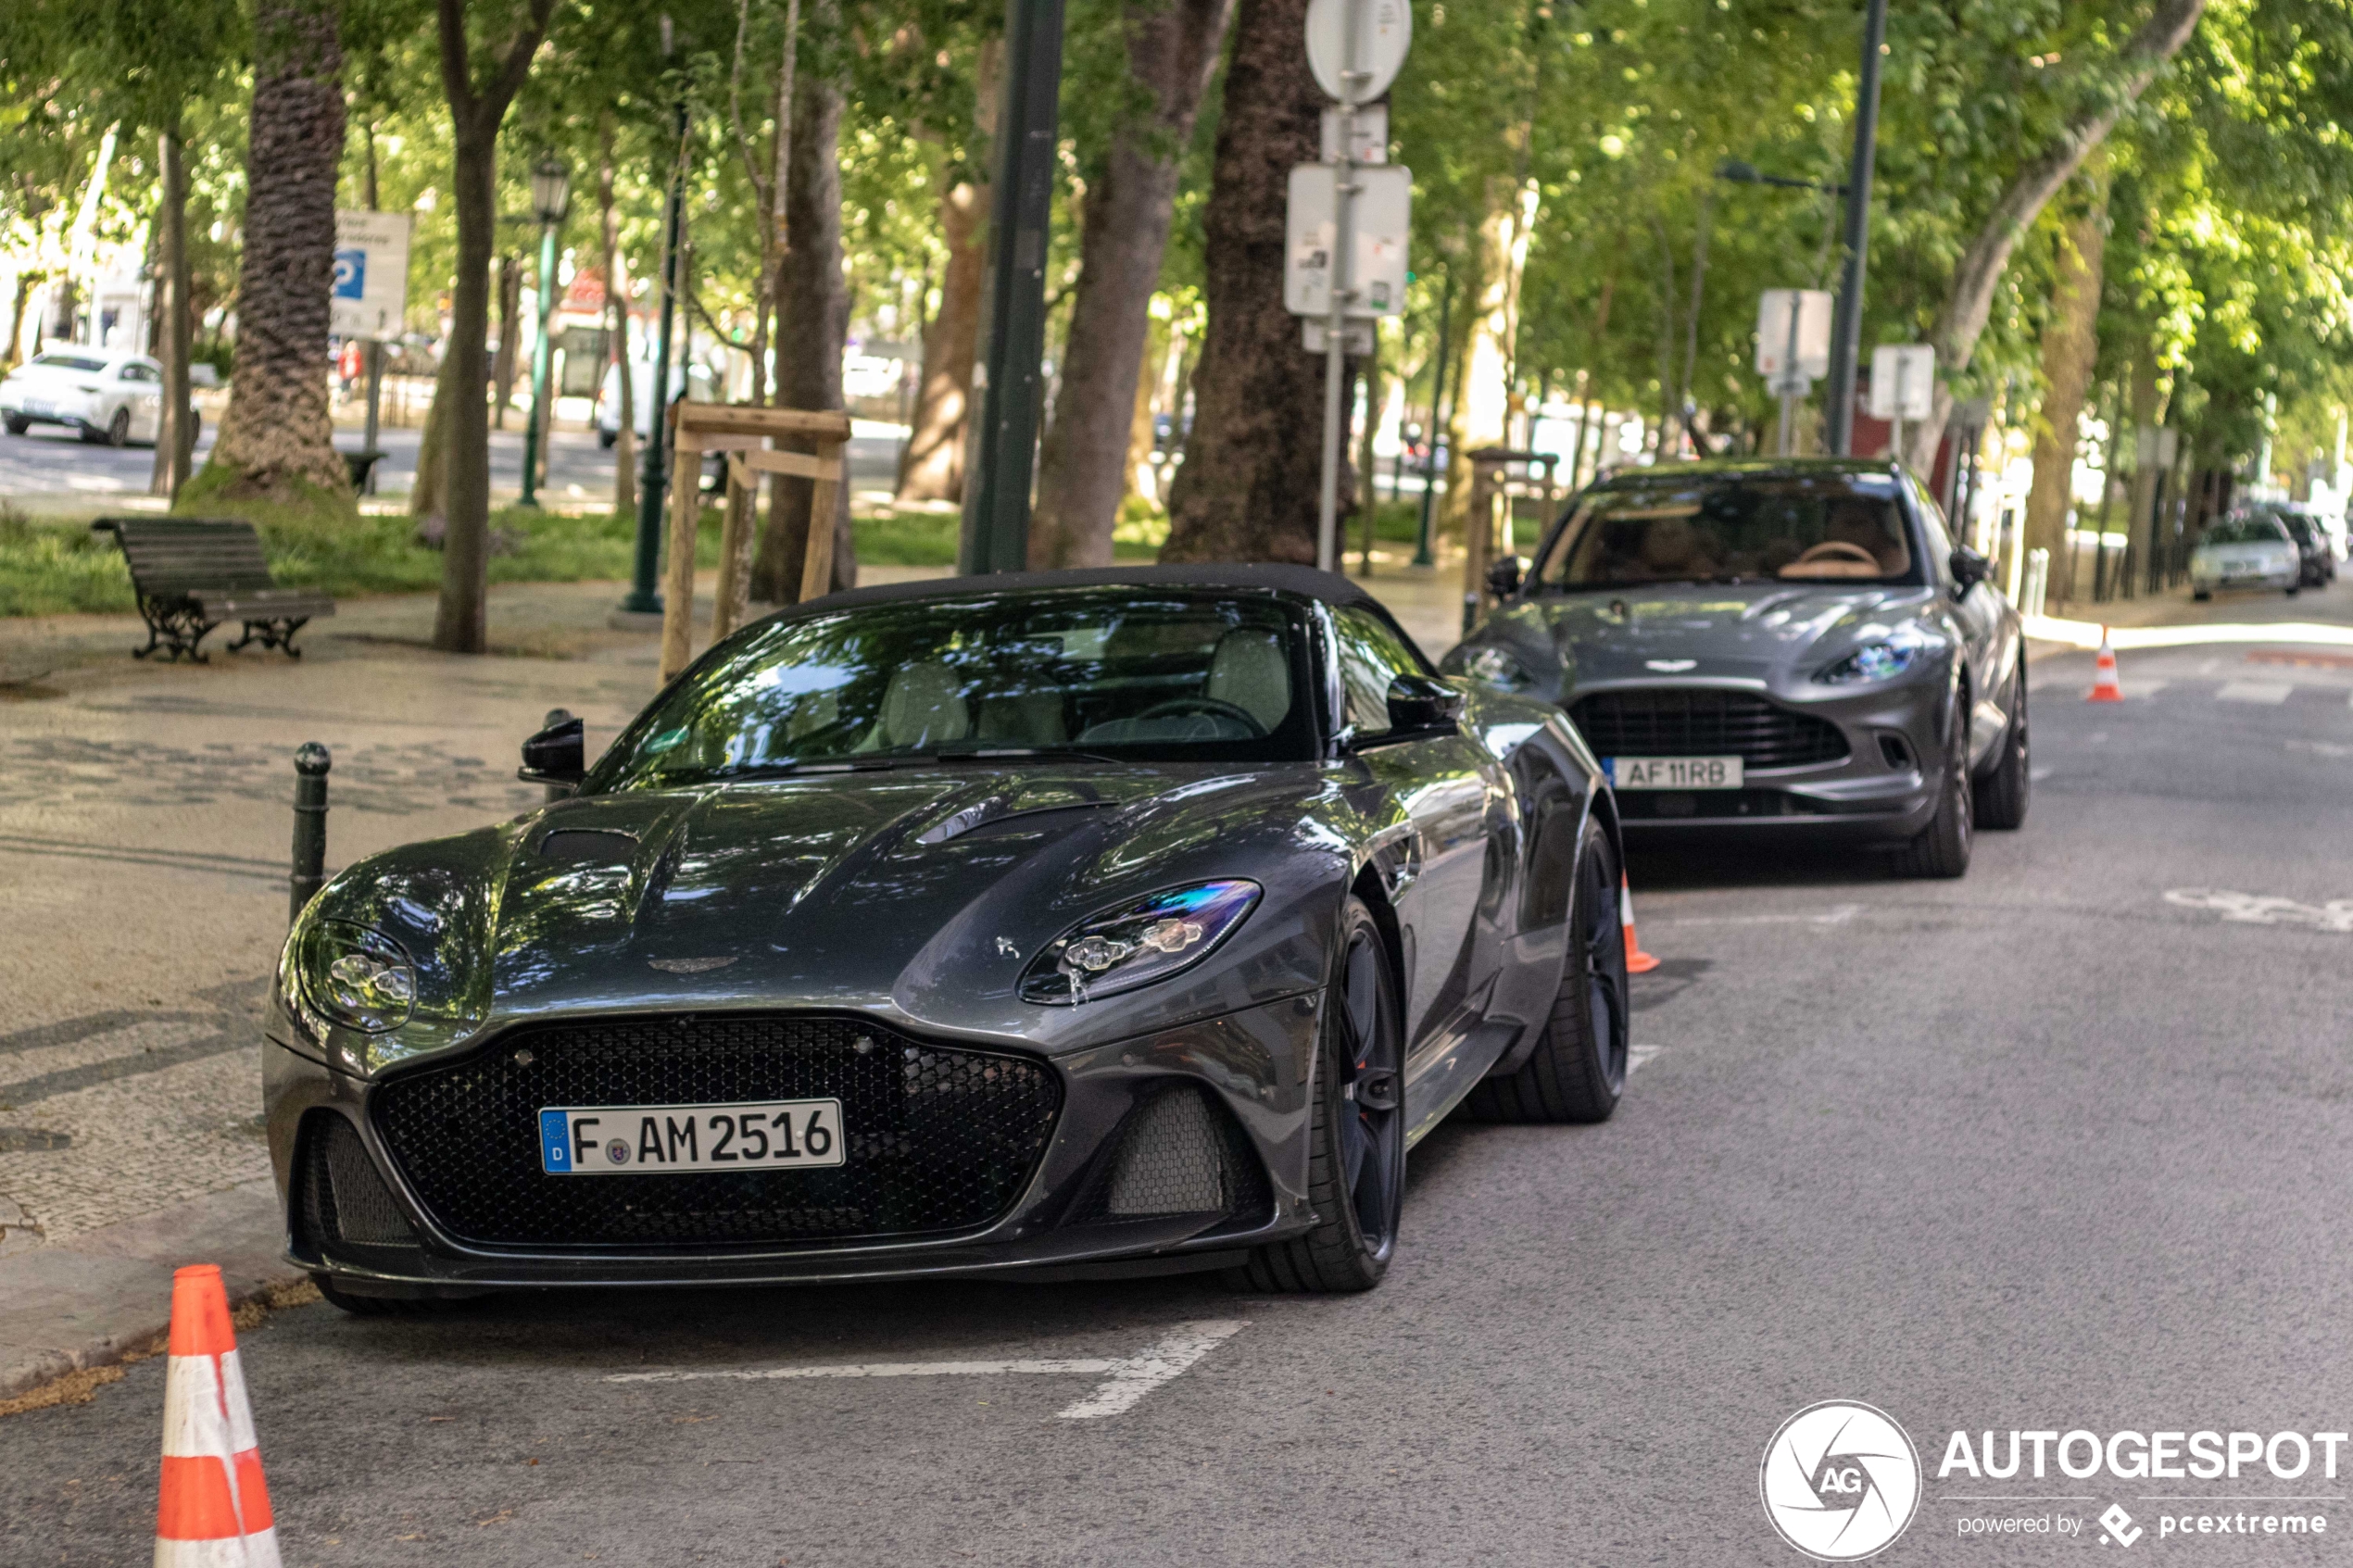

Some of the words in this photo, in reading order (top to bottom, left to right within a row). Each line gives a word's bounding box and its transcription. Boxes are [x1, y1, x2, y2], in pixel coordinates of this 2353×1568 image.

[573, 1118, 600, 1164] F
[637, 1115, 698, 1163] AM
[709, 1110, 832, 1161] 2516
[552, 1148, 563, 1160] D
